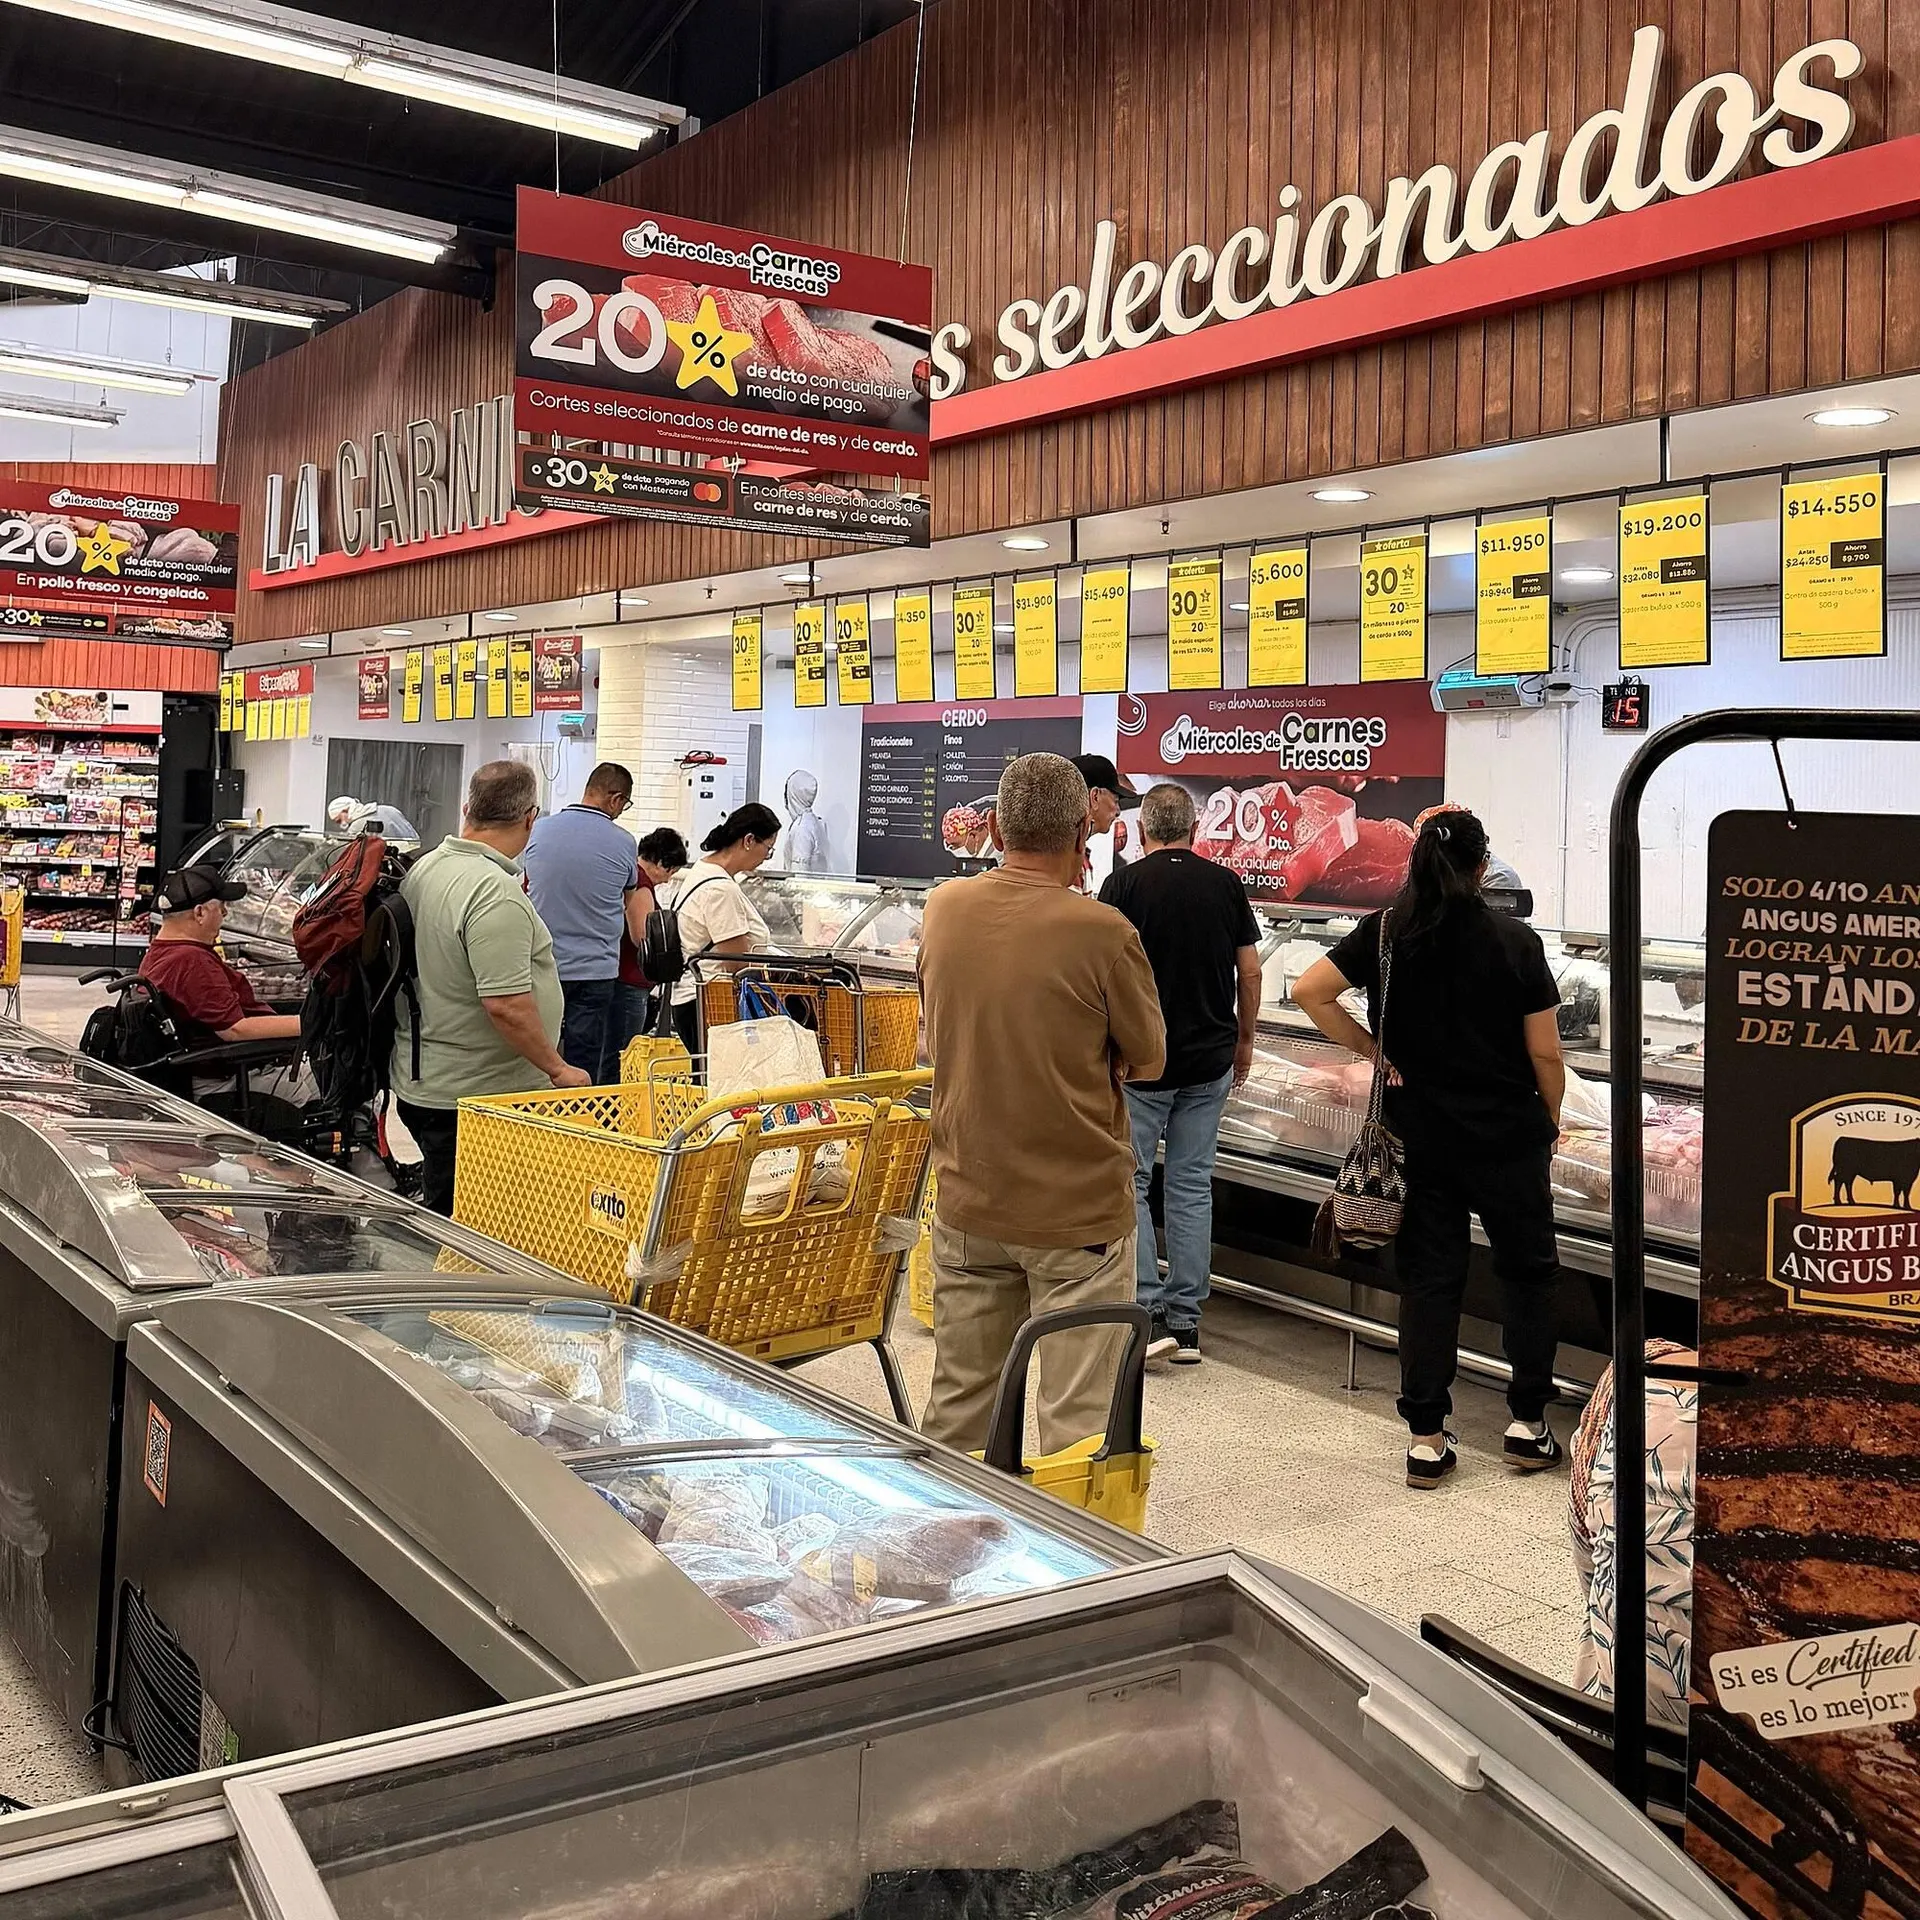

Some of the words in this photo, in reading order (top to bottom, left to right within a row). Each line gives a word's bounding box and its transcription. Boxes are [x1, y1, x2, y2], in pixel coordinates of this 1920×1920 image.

[993, 25, 1867, 382] seleccionados
[642, 232, 734, 265] Miércoles
[736, 254, 751, 268] de
[752, 245, 840, 282] Carnes
[752, 265, 828, 295] Frescas
[529, 278, 668, 374] 20
[691, 330, 726, 369] %
[746, 361, 767, 379] de
[769, 366, 807, 385] dcto
[809, 373, 839, 390] con
[841, 378, 913, 401] cualquier
[746, 382, 797, 402] medio
[799, 389, 819, 406] de
[822, 396, 867, 414] pago.
[529, 389, 590, 413] Cortes
[593, 400, 715, 430] seleccionados
[717, 416, 739, 434] de
[741, 421, 788, 441] carne
[790, 425, 811, 443] de
[812, 430, 837, 446] res
[839, 435, 849, 450] y
[851, 435, 870, 451] de
[872, 439, 919, 458] cerdo.
[545, 456, 588, 489] 30
[621, 472, 632, 482] de
[633, 473, 652, 484] dcto
[654, 475, 691, 489] pagando
[622, 482, 639, 493] con
[639, 483, 689, 498] Mastercard
[740, 481, 759, 497] En
[761, 484, 805, 501] cortes
[806, 490, 903, 512] seleccionados
[904, 499, 922, 514] de
[60, 492, 115, 510] Miércoles
[124, 497, 178, 514] Carnes
[124, 508, 171, 521] Frescas
[1787, 492, 1877, 519] $14.550
[262, 463, 321, 575] LA
[753, 501, 794, 516] carne
[796, 502, 815, 518] de
[816, 507, 838, 520] res
[839, 511, 849, 524] y
[850, 507, 868, 524] de
[870, 513, 912, 529] cerdo.
[1623, 512, 1702, 539] $19.200
[0, 518, 78, 567] 20
[91, 541, 113, 562] %
[1382, 538, 1411, 551] oferta
[1481, 533, 1546, 556] $11.950
[124, 555, 139, 568] de
[139, 556, 164, 570] dcto
[164, 560, 185, 571] con
[184, 562, 233, 576] cualquier
[1785, 555, 1829, 569] $24.250
[124, 566, 157, 578] medio
[157, 568, 172, 580] de
[172, 571, 202, 584] pago.
[1250, 563, 1304, 586] $5.600
[1365, 566, 1399, 597] 30
[1622, 570, 1660, 583] $32.080
[16, 572, 36, 587] En
[38, 574, 74, 591] pollo
[75, 575, 121, 593] fresco
[122, 582, 132, 595] y
[133, 584, 210, 602] congelado.
[1084, 585, 1125, 602] $15.490
[1015, 594, 1054, 612] $31.900
[1171, 590, 1198, 617] 30
[1389, 601, 1405, 615] 20
[1819, 601, 1833, 609] 500
[3, 608, 29, 626] 30
[956, 612, 975, 634] 30
[1190, 621, 1205, 633] 20
[796, 621, 811, 643] 20
[837, 618, 852, 640] 20
[1397, 629, 1413, 637] 500g
[734, 635, 748, 654] 30
[971, 638, 981, 649] 20
[1208, 699, 1227, 712] Elige
[1227, 692, 1272, 711] ahorrar
[1271, 697, 1295, 709] todos
[1295, 697, 1308, 708] los
[1308, 696, 1327, 708] días
[1614, 696, 1640, 725] 15
[941, 707, 987, 728] CERDO
[869, 736, 914, 747] Tradicionales
[943, 733, 963, 746] Finos
[1177, 724, 1264, 752] Miércoles
[1265, 732, 1281, 749] de
[1282, 715, 1386, 744] Carnes
[1281, 744, 1369, 769] Frescas
[1206, 789, 1267, 842] 20
[1270, 809, 1289, 833] %
[1268, 836, 1292, 851] Dto.
[1231, 854, 1286, 872] cualquier
[1240, 873, 1256, 887] de
[1256, 875, 1289, 891] pago.
[1721, 875, 1805, 900] SOLO
[1809, 880, 1869, 903] 4/10
[1741, 907, 1838, 935] ANGUS
[1723, 937, 1866, 967] LOGRAN
[1735, 1016, 1796, 1047] DE
[1800, 1021, 1861, 1052] LA
[1778, 1252, 1894, 1285] ANGUS
[1718, 1665, 1747, 1690] Si
[1751, 1666, 1779, 1686] es
[1760, 1709, 1788, 1729] es
[1789, 1698, 1818, 1724] lo
